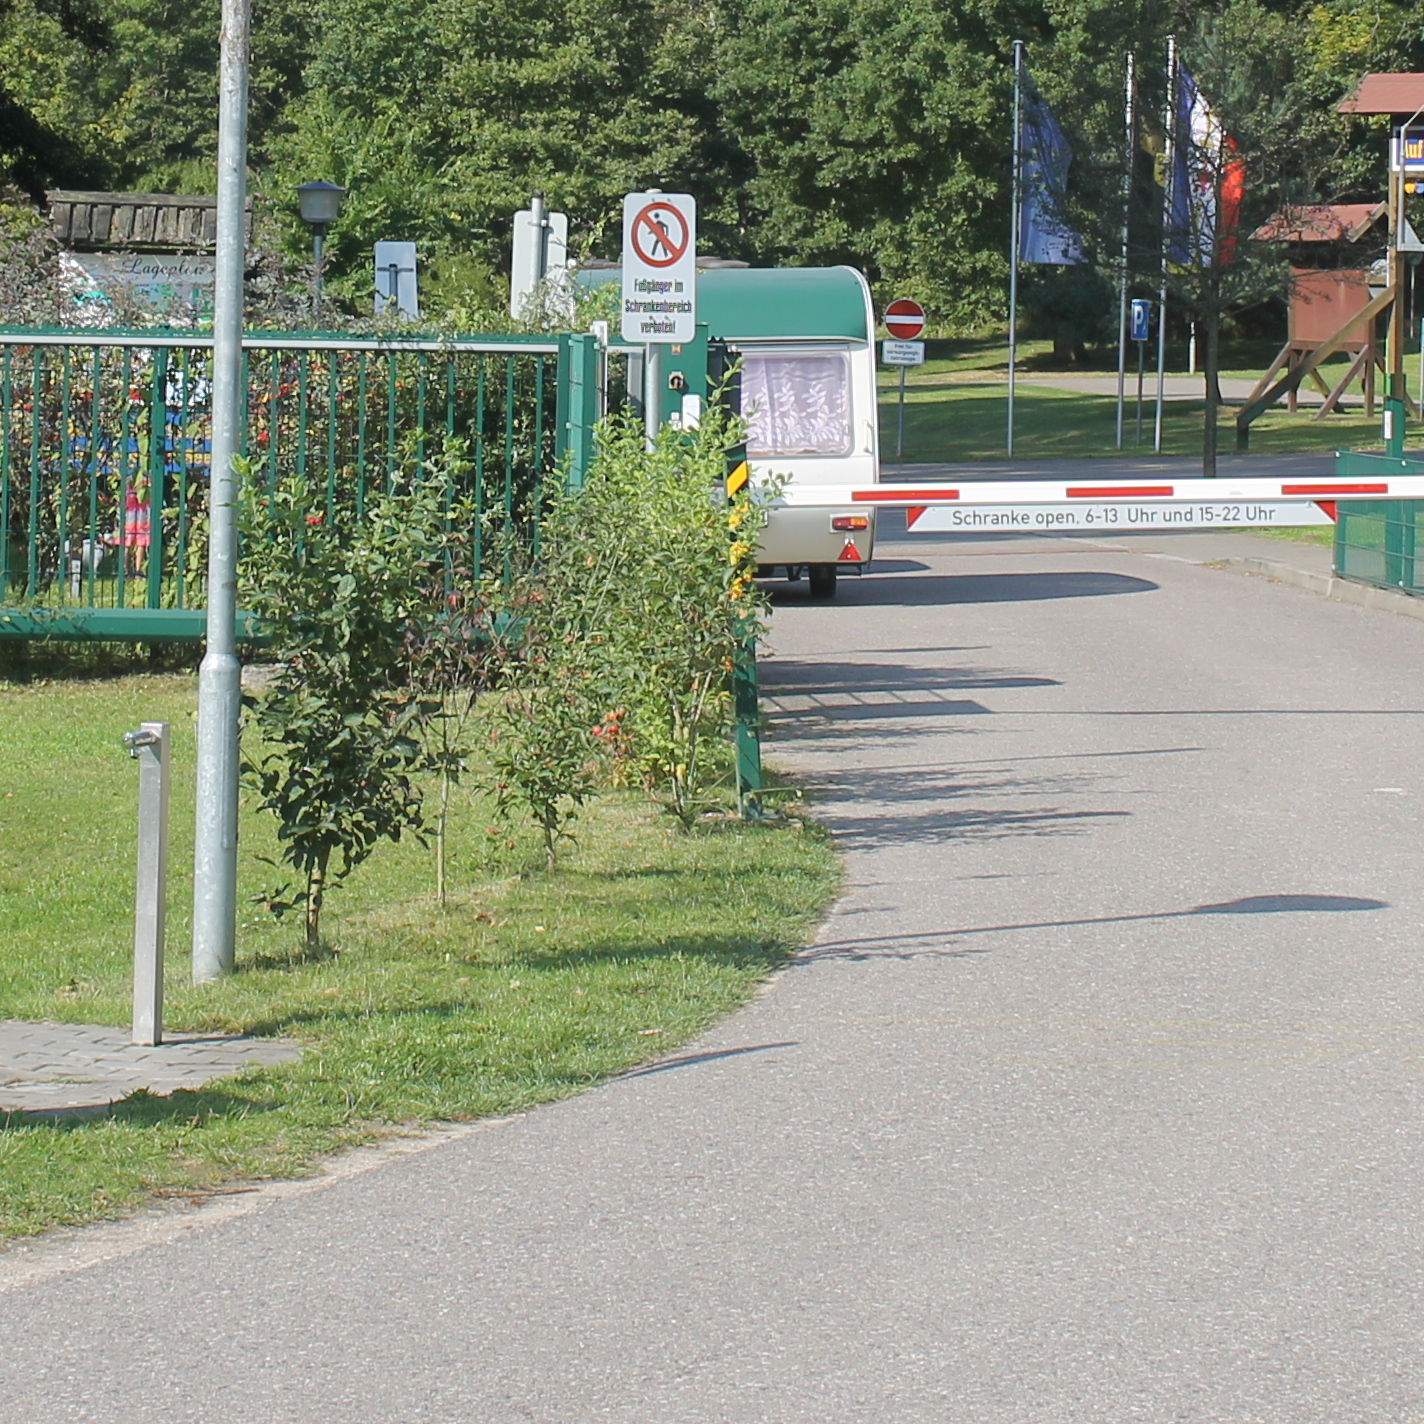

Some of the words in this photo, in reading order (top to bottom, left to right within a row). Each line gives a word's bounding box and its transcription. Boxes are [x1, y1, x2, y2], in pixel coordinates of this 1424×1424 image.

[625, 298, 692, 313] Schrankenbereich
[640, 320, 676, 334] verboten!
[952, 509, 1030, 525] Schranke
[1085, 508, 1119, 524] 6-13
[1127, 507, 1157, 523] Uhr
[1162, 507, 1193, 522] und
[1199, 506, 1240, 522] 15-22
[1245, 506, 1276, 521] Uhr
